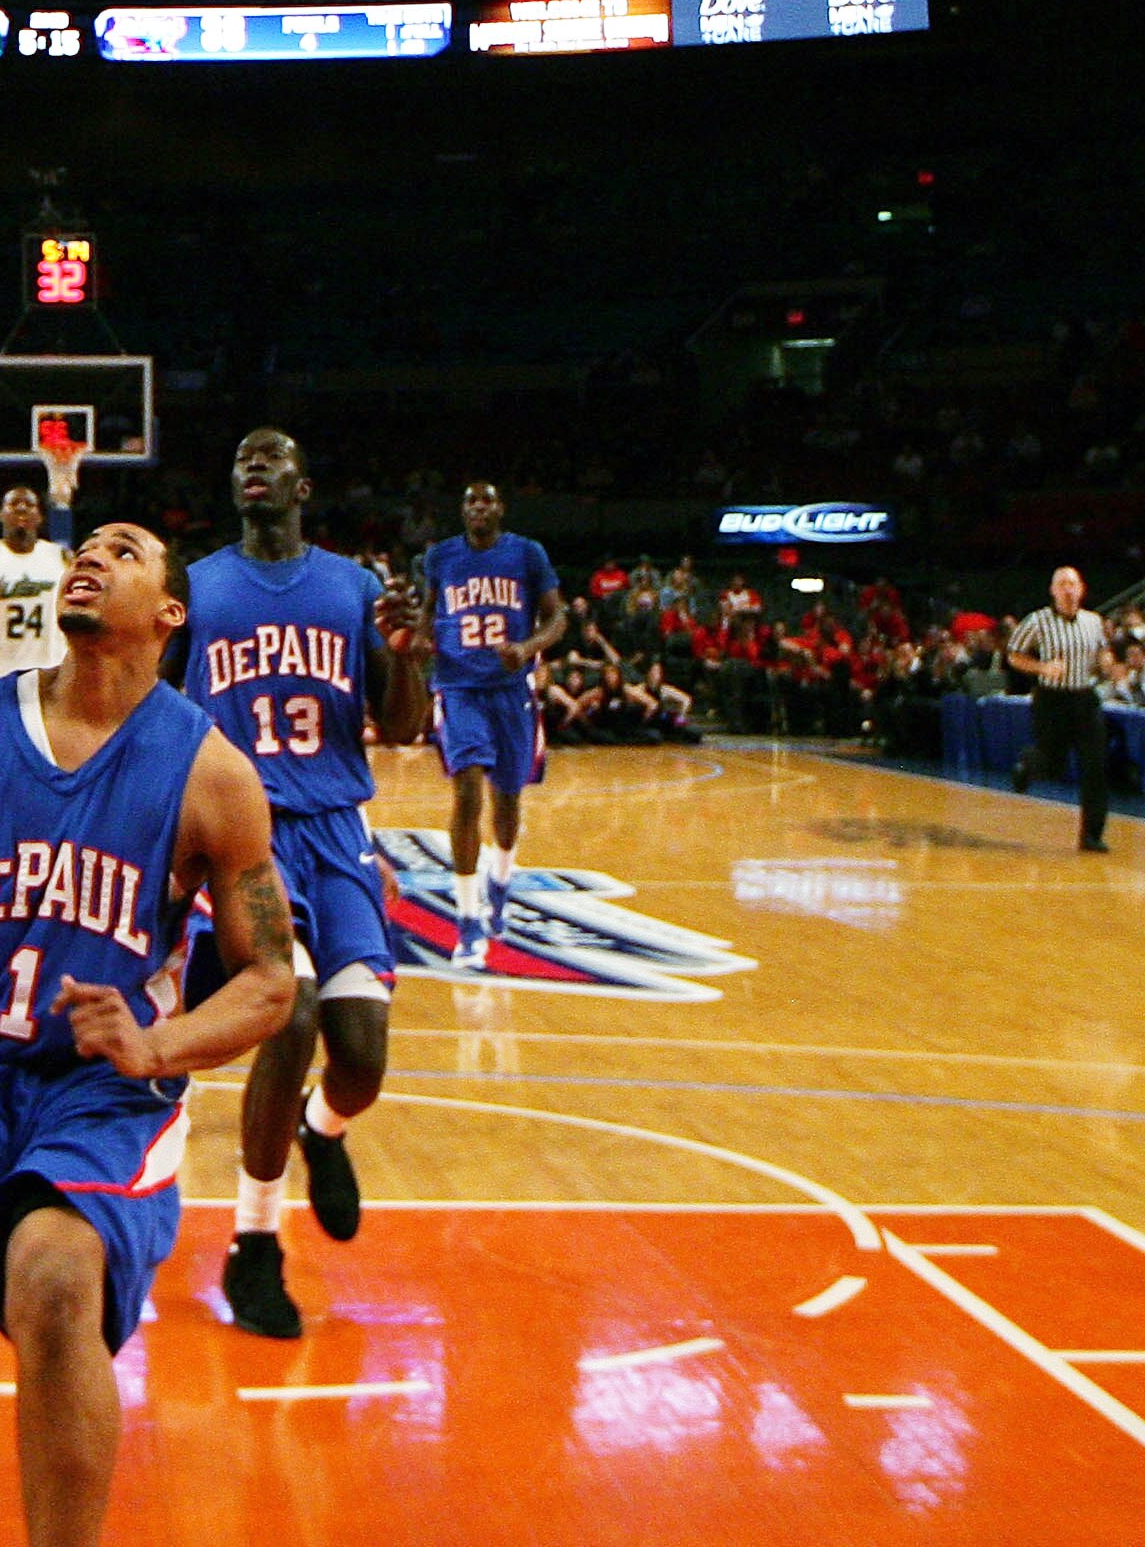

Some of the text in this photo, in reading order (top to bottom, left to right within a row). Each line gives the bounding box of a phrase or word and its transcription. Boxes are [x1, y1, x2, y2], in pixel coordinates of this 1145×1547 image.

[37, 260, 88, 303] 32
[718, 512, 888, 533] BUD LIGHT
[5, 602, 44, 640] 24
[459, 612, 509, 648] 22
[251, 692, 324, 757] 13
